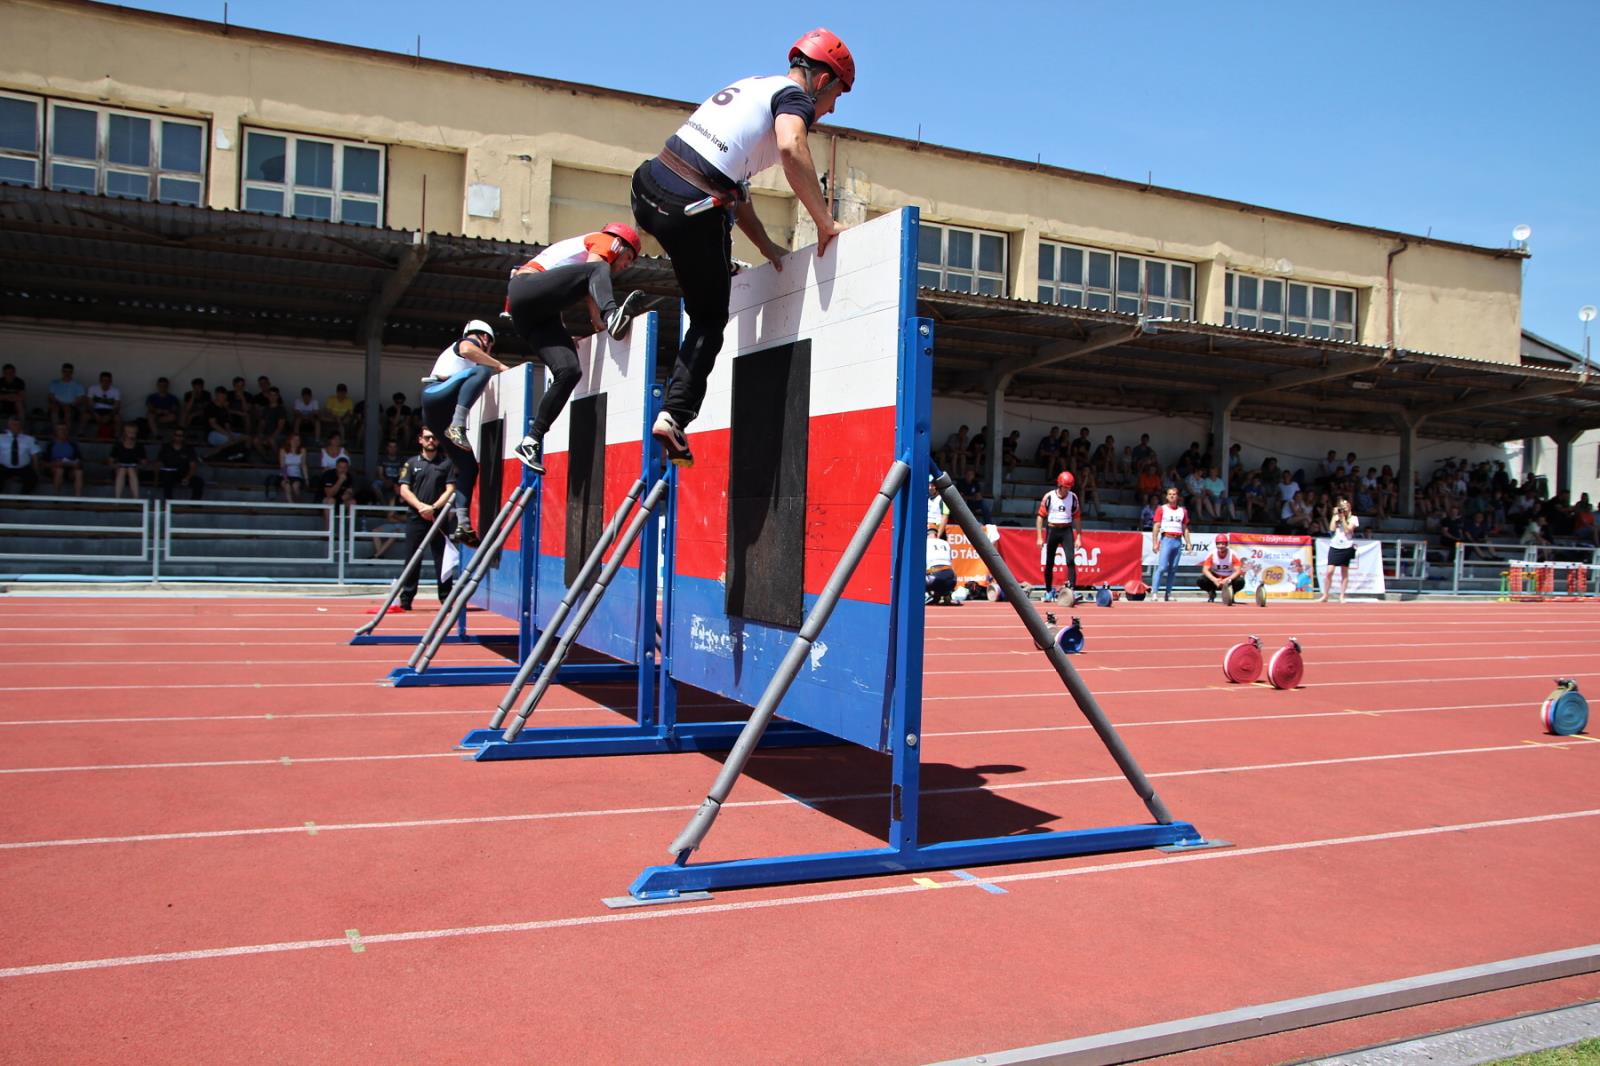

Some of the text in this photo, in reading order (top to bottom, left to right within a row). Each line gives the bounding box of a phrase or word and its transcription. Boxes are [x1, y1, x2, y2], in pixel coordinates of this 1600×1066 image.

[712, 87, 740, 106] 6
[711, 134, 729, 153] kraje
[1250, 549, 1264, 559] 20
